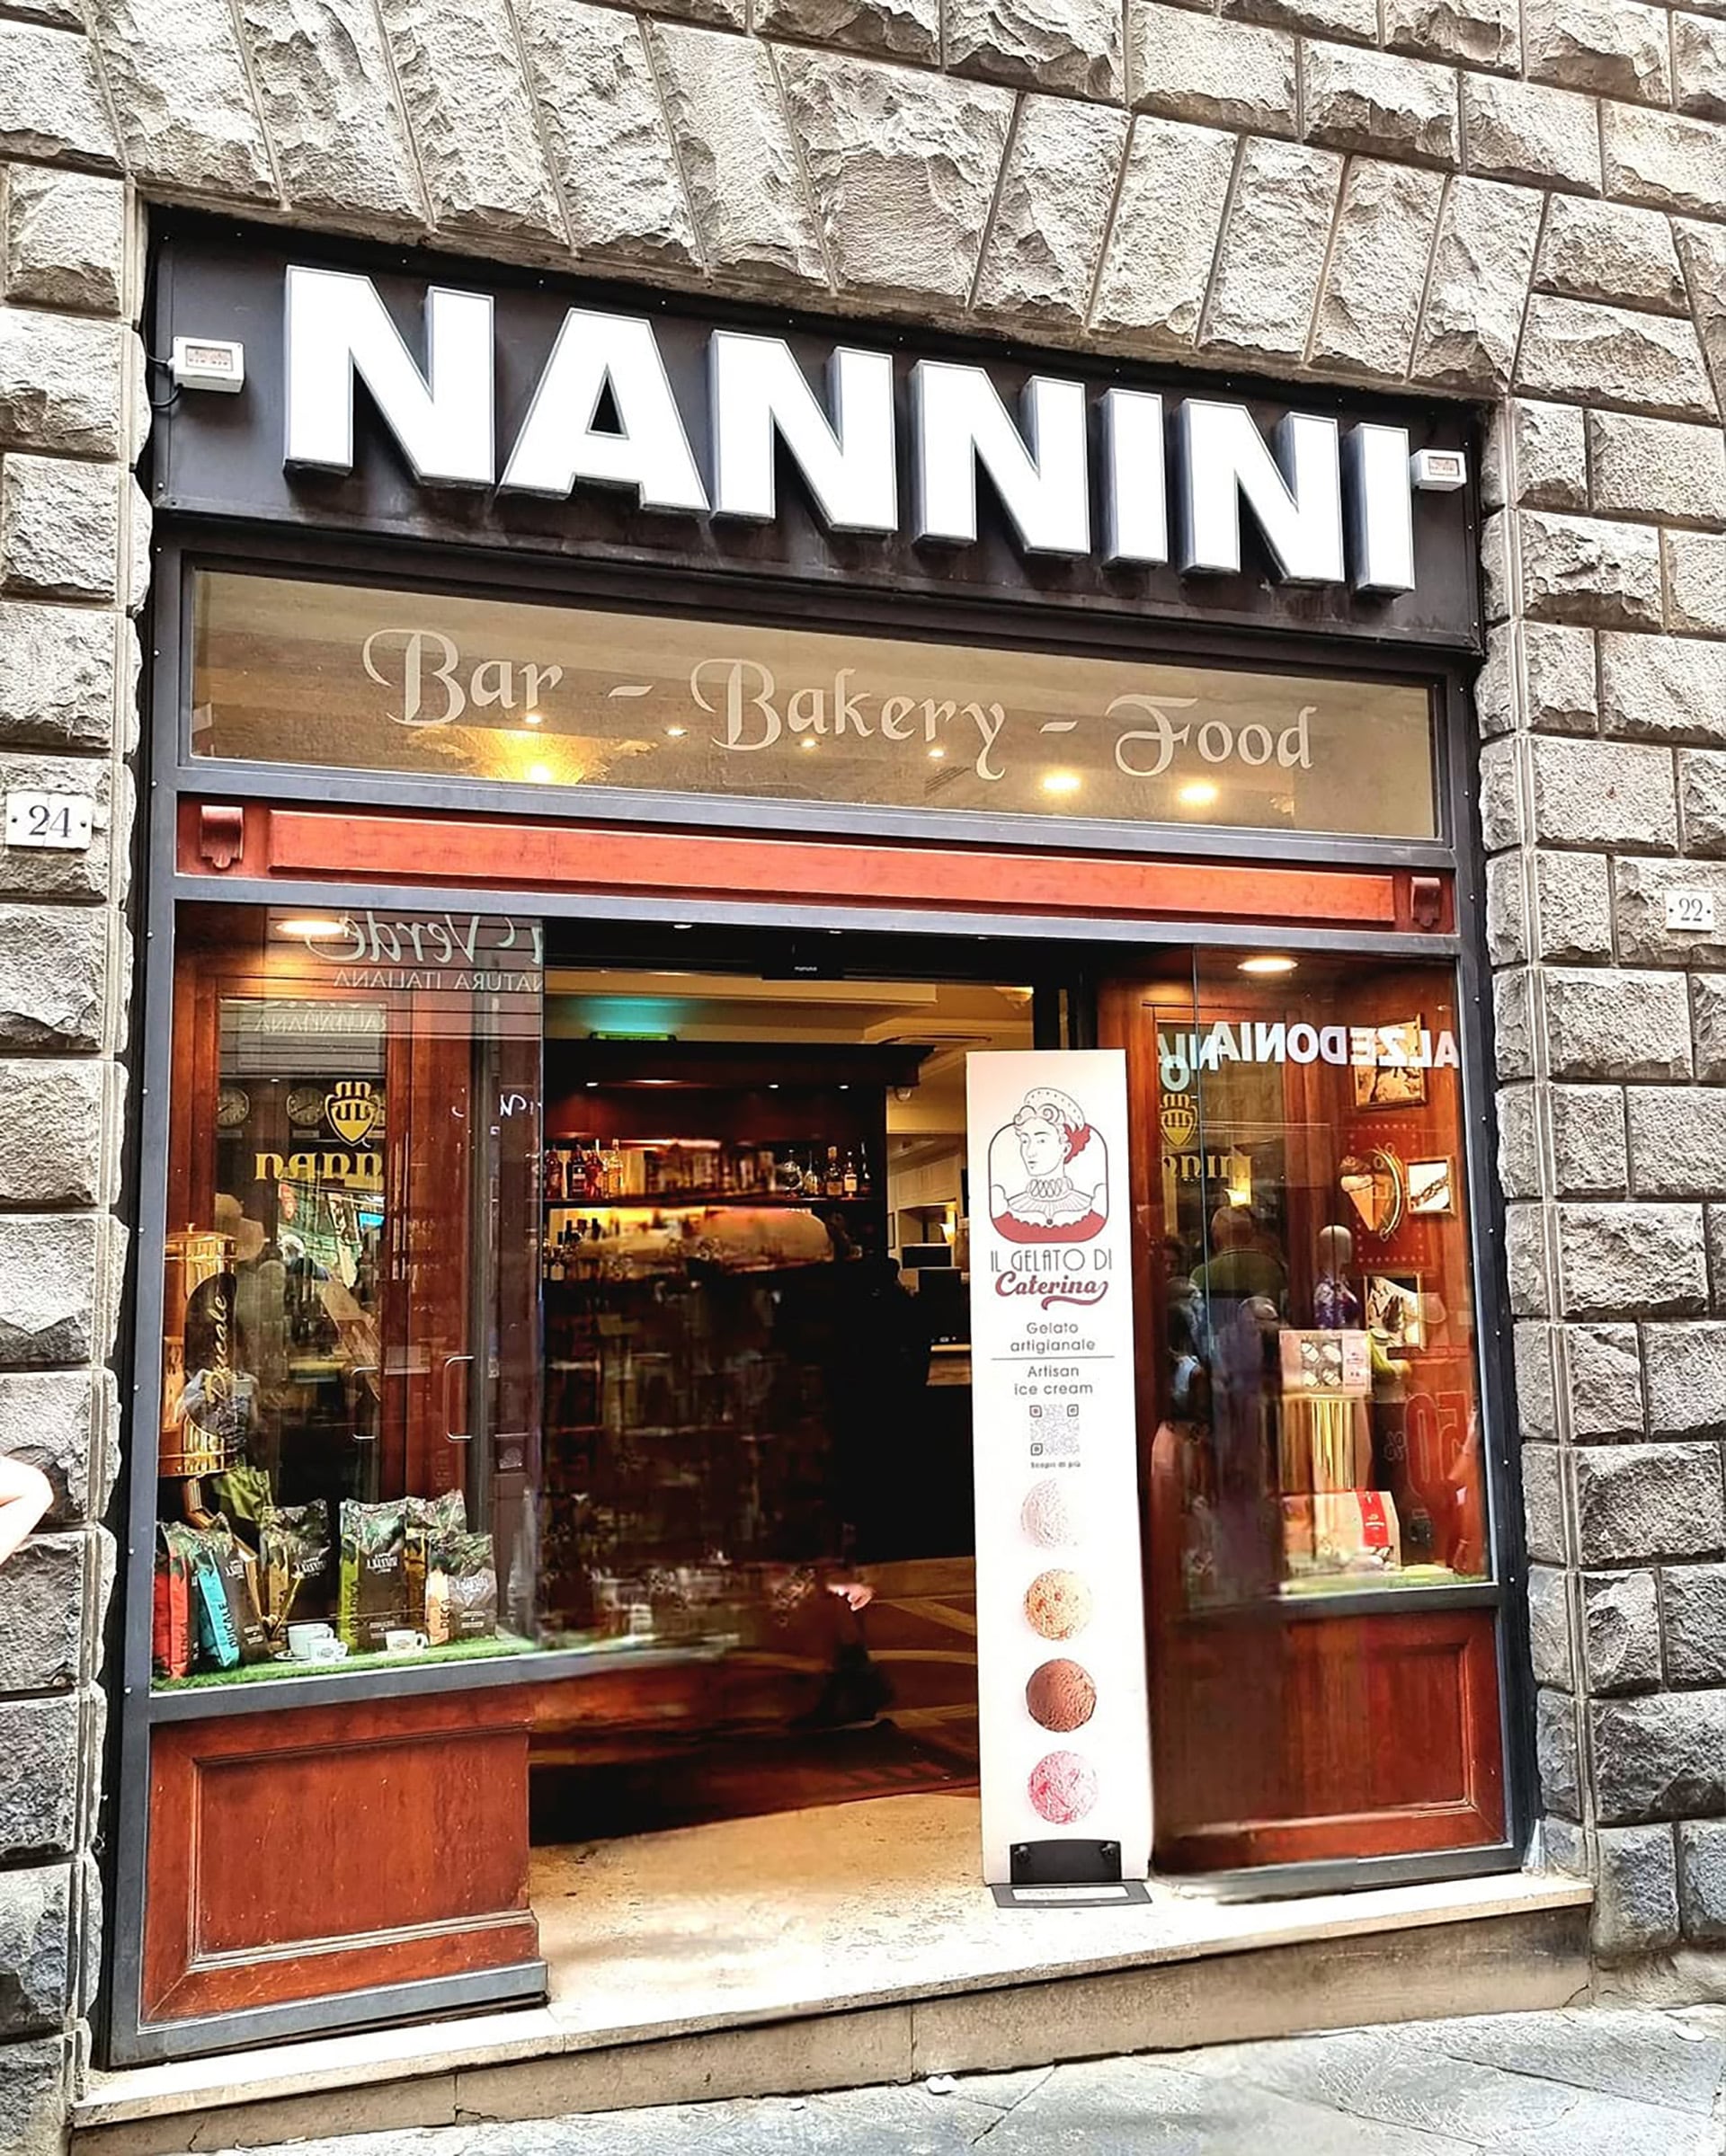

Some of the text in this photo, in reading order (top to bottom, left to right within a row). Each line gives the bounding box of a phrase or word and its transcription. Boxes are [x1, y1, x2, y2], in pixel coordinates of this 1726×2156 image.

[283, 265, 1416, 595] NANNINI
[362, 628, 564, 727] Bar
[690, 657, 1007, 780] Bakery
[1105, 693, 1318, 776] Food
[29, 804, 71, 838] 24
[1678, 898, 1704, 922] 22
[991, 1248, 1112, 1272] IL GELATO DI
[995, 1271, 1108, 1310] Caterina
[1027, 1322, 1079, 1335] Gelato
[1010, 1338, 1095, 1354] artigianale
[1028, 1365, 1079, 1378] Artisan
[1014, 1383, 1093, 1395] ice cream
